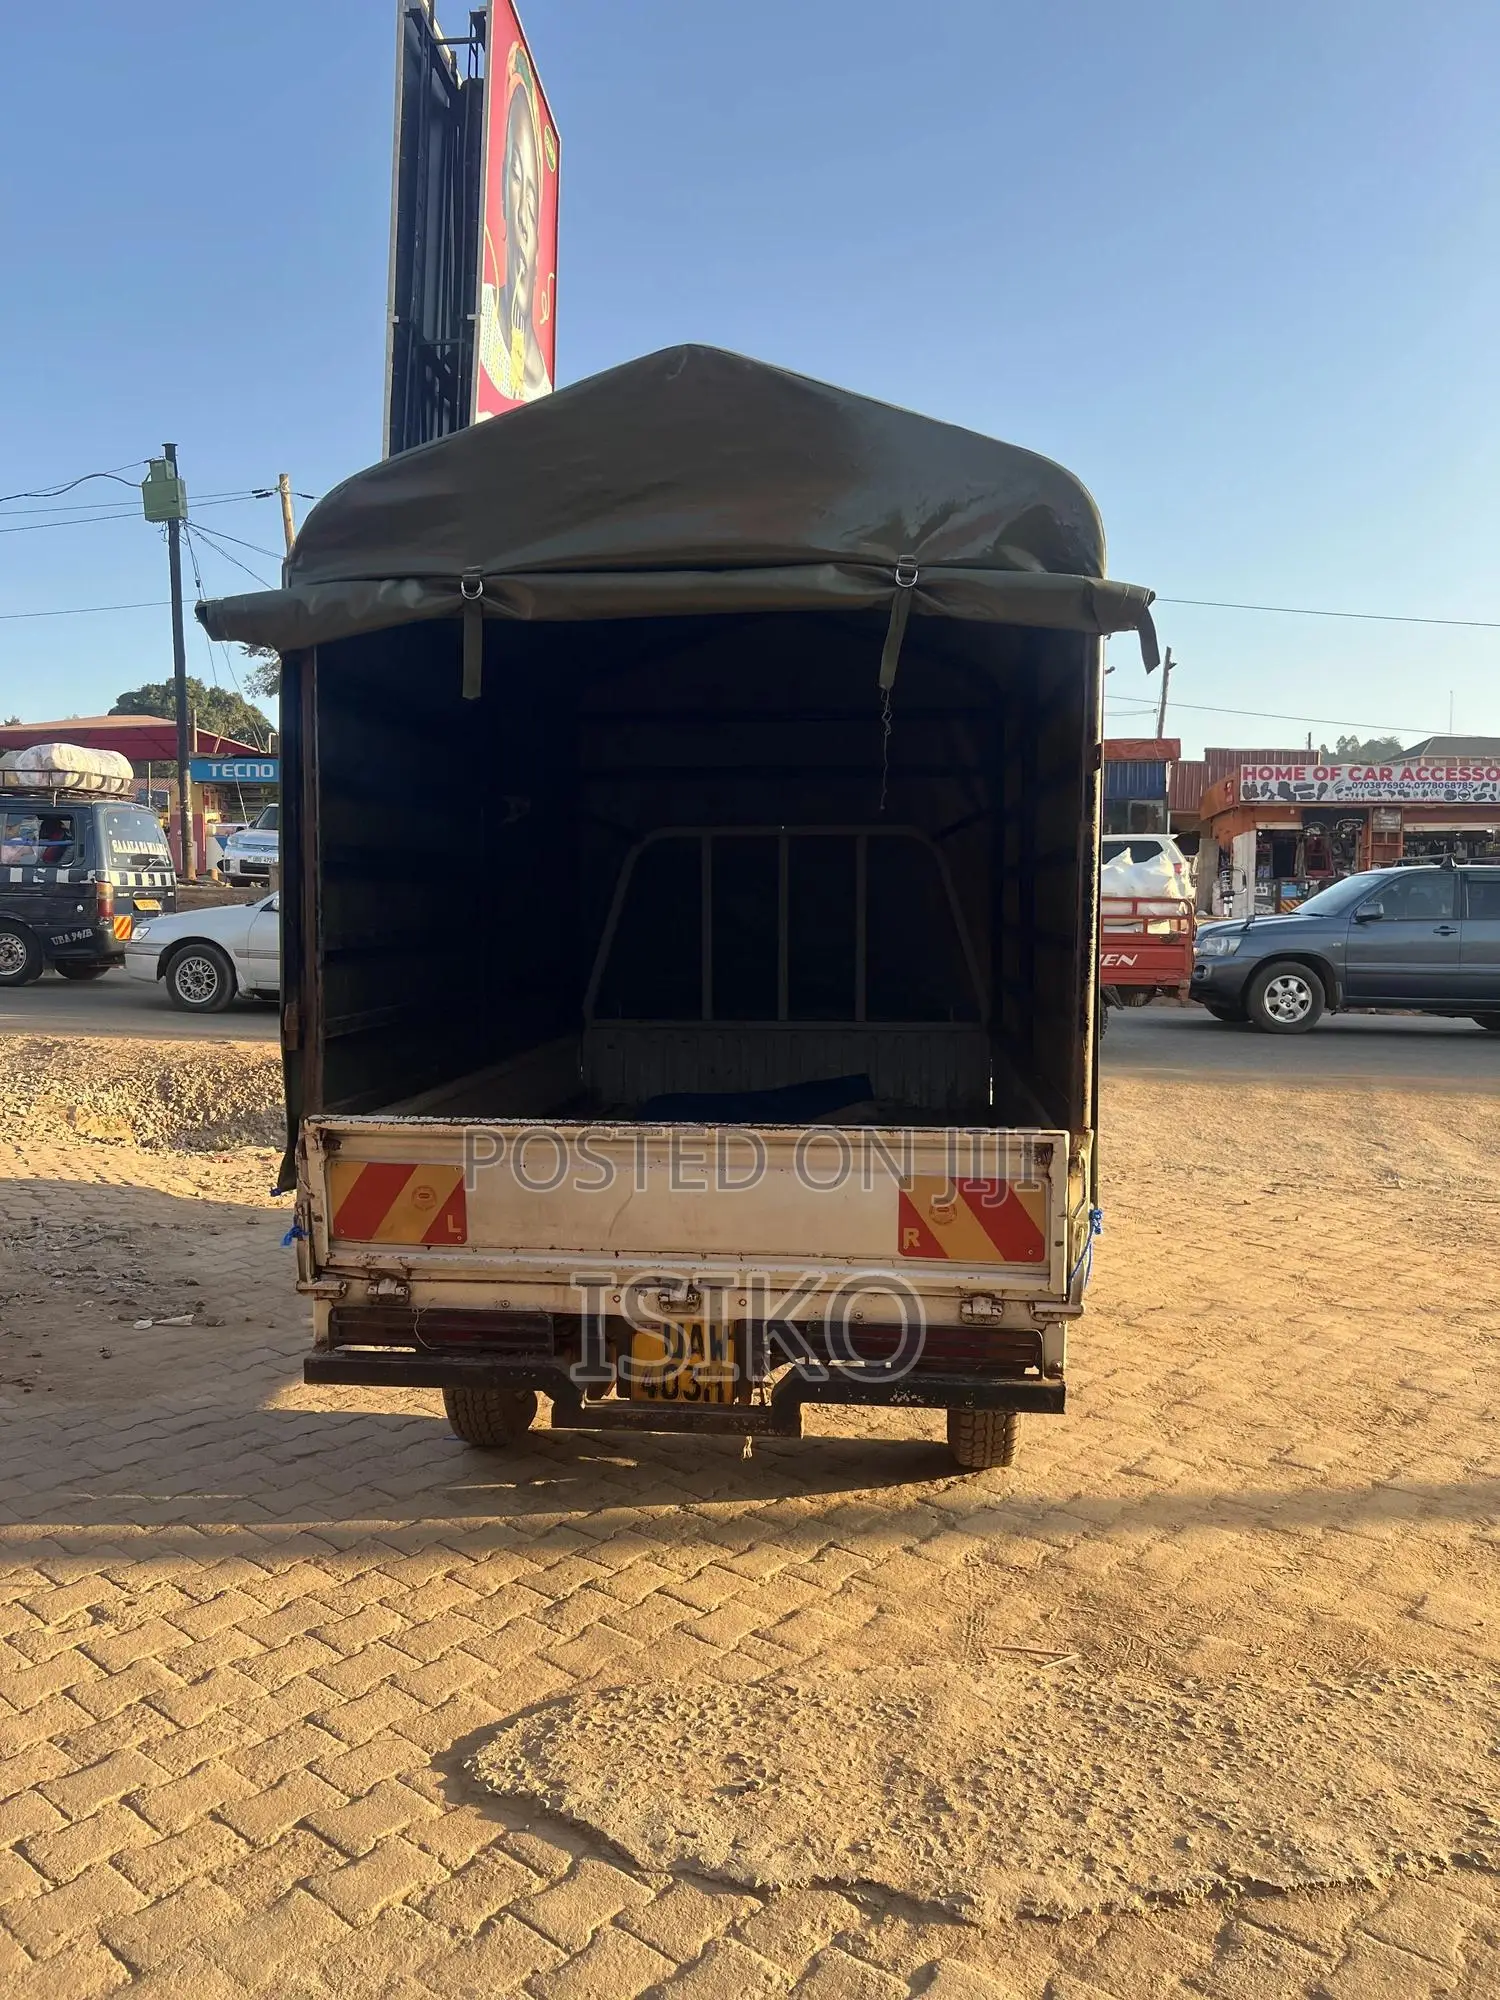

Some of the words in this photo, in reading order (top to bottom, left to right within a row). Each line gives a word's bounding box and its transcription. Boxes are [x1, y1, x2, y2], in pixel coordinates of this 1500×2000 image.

[207, 763, 274, 778] TECNO
[1241, 766, 1306, 781] HOME
[1312, 766, 1342, 781] OF
[1347, 766, 1393, 781] CAR
[1398, 766, 1500, 781] ACCESSO
[1099, 953, 1138, 966] EN
[447, 1214, 462, 1233] L
[903, 1227, 920, 1248] R
